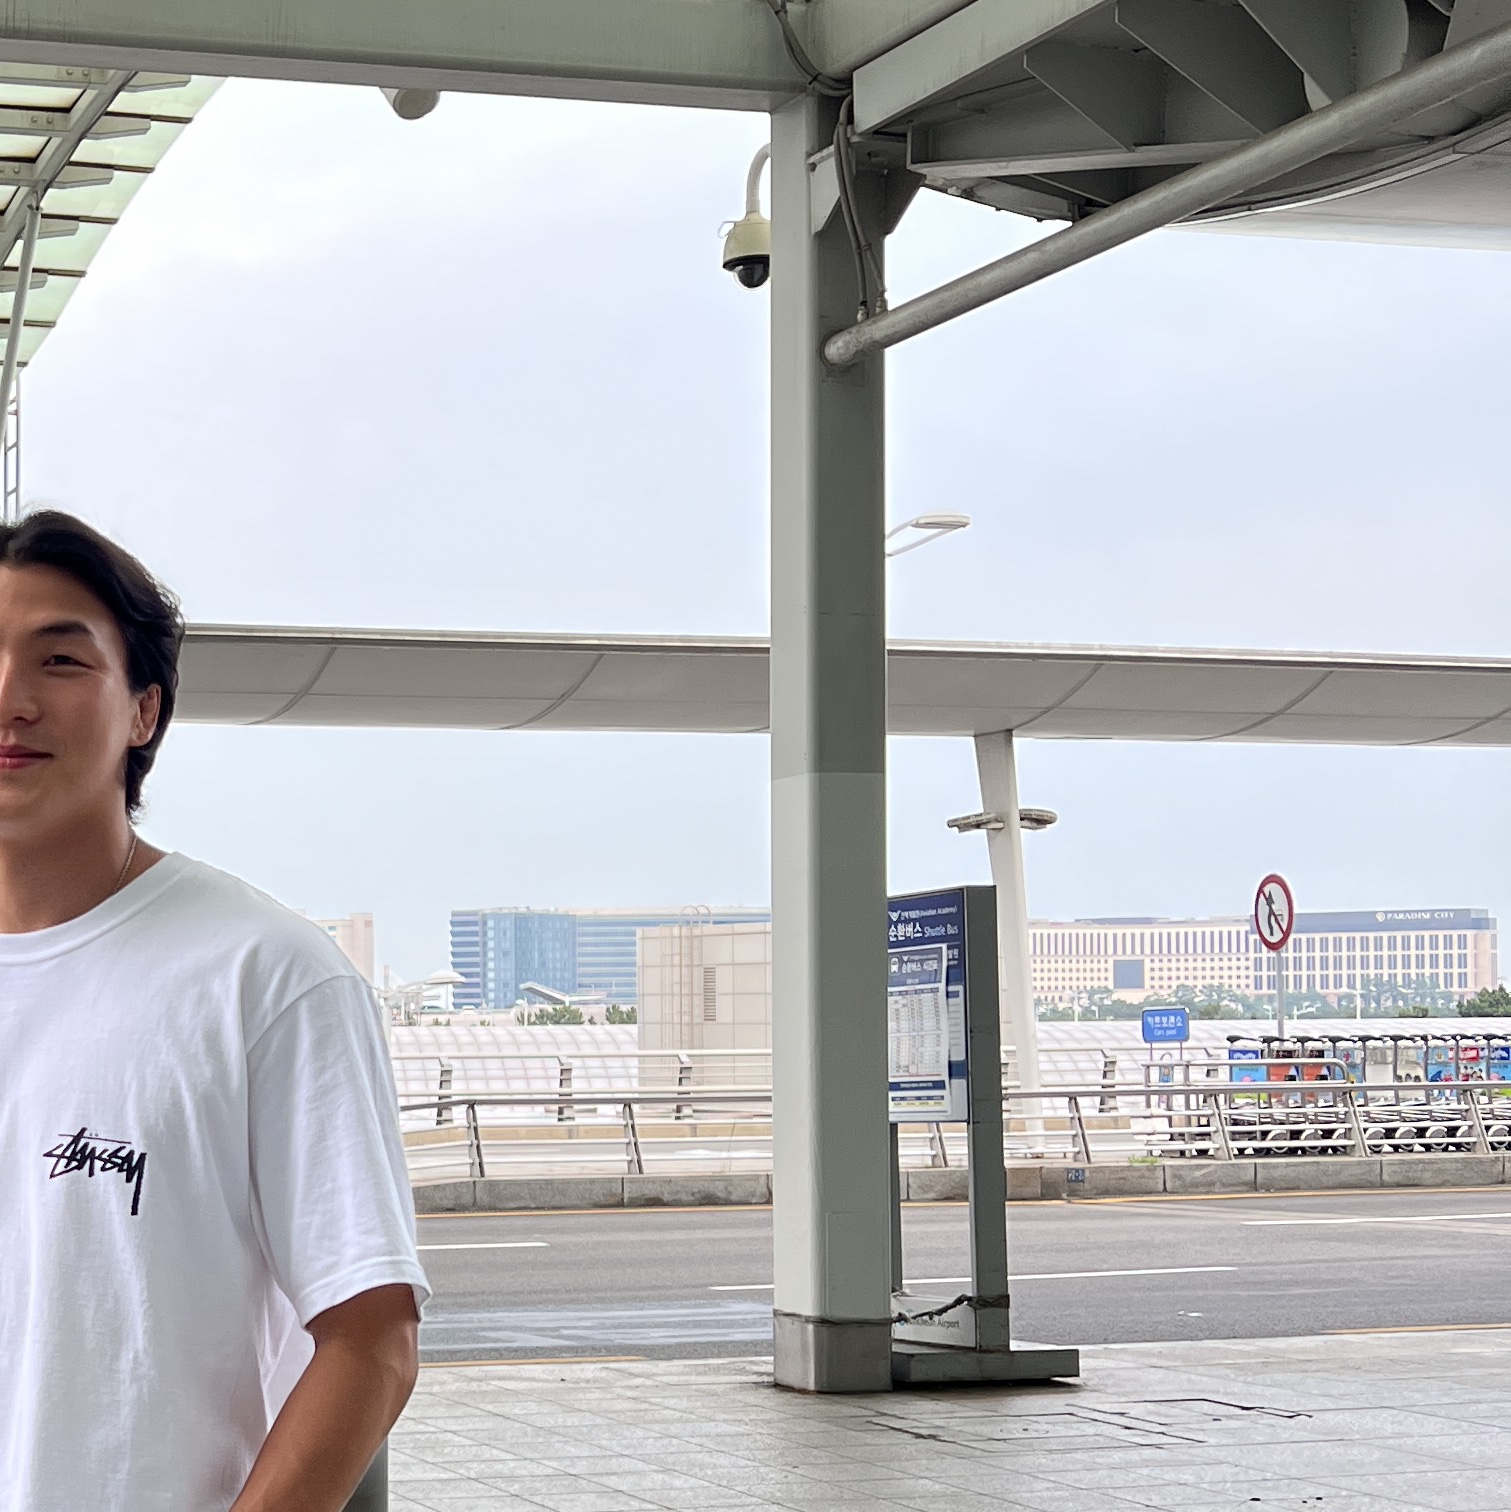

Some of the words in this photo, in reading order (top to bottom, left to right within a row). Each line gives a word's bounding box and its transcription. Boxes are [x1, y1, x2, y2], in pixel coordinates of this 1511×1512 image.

[1387, 911, 1432, 920] PARADISE
[1434, 911, 1455, 919] CITY
[889, 922, 923, 942] 순환버스
[947, 923, 959, 935] Bus
